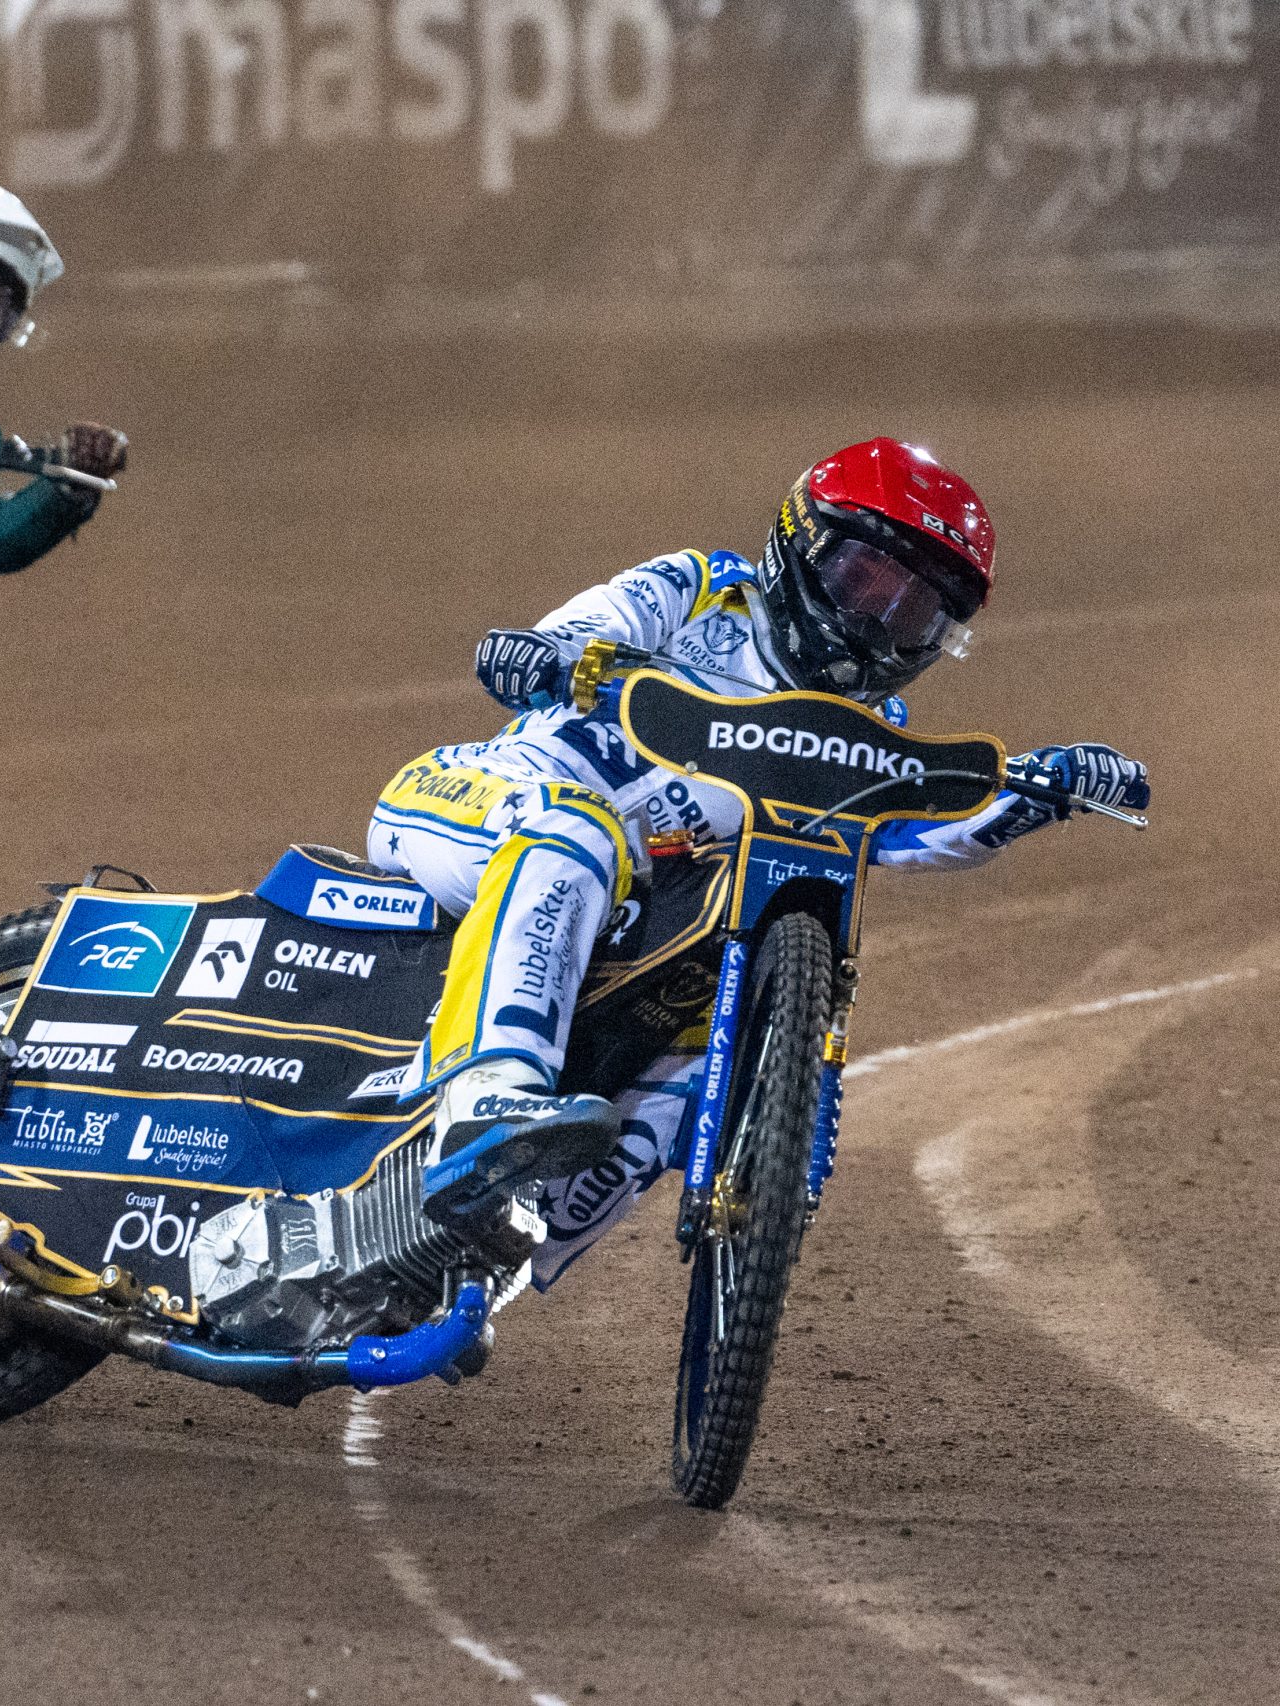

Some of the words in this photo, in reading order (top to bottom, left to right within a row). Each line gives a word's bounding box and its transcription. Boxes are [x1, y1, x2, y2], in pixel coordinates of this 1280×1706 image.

[157, 0, 675, 191] maspo
[708, 721, 926, 786] BOGDANKA
[353, 895, 417, 915] ORLEN
[79, 944, 148, 970] PGE
[513, 879, 572, 999] lubelskie
[273, 939, 377, 979] ORLEN
[263, 970, 300, 993] OIL
[720, 967, 740, 1017] ORLEN
[10, 1045, 118, 1074] SOUDAL
[141, 1044, 305, 1083] BOGDANKA
[705, 1052, 724, 1101] ORLEN
[13, 1139, 48, 1151] MIASTO
[152, 1122, 230, 1151] lubelskie
[690, 1136, 710, 1185] ORLEN
[125, 1191, 157, 1208] Grupa
